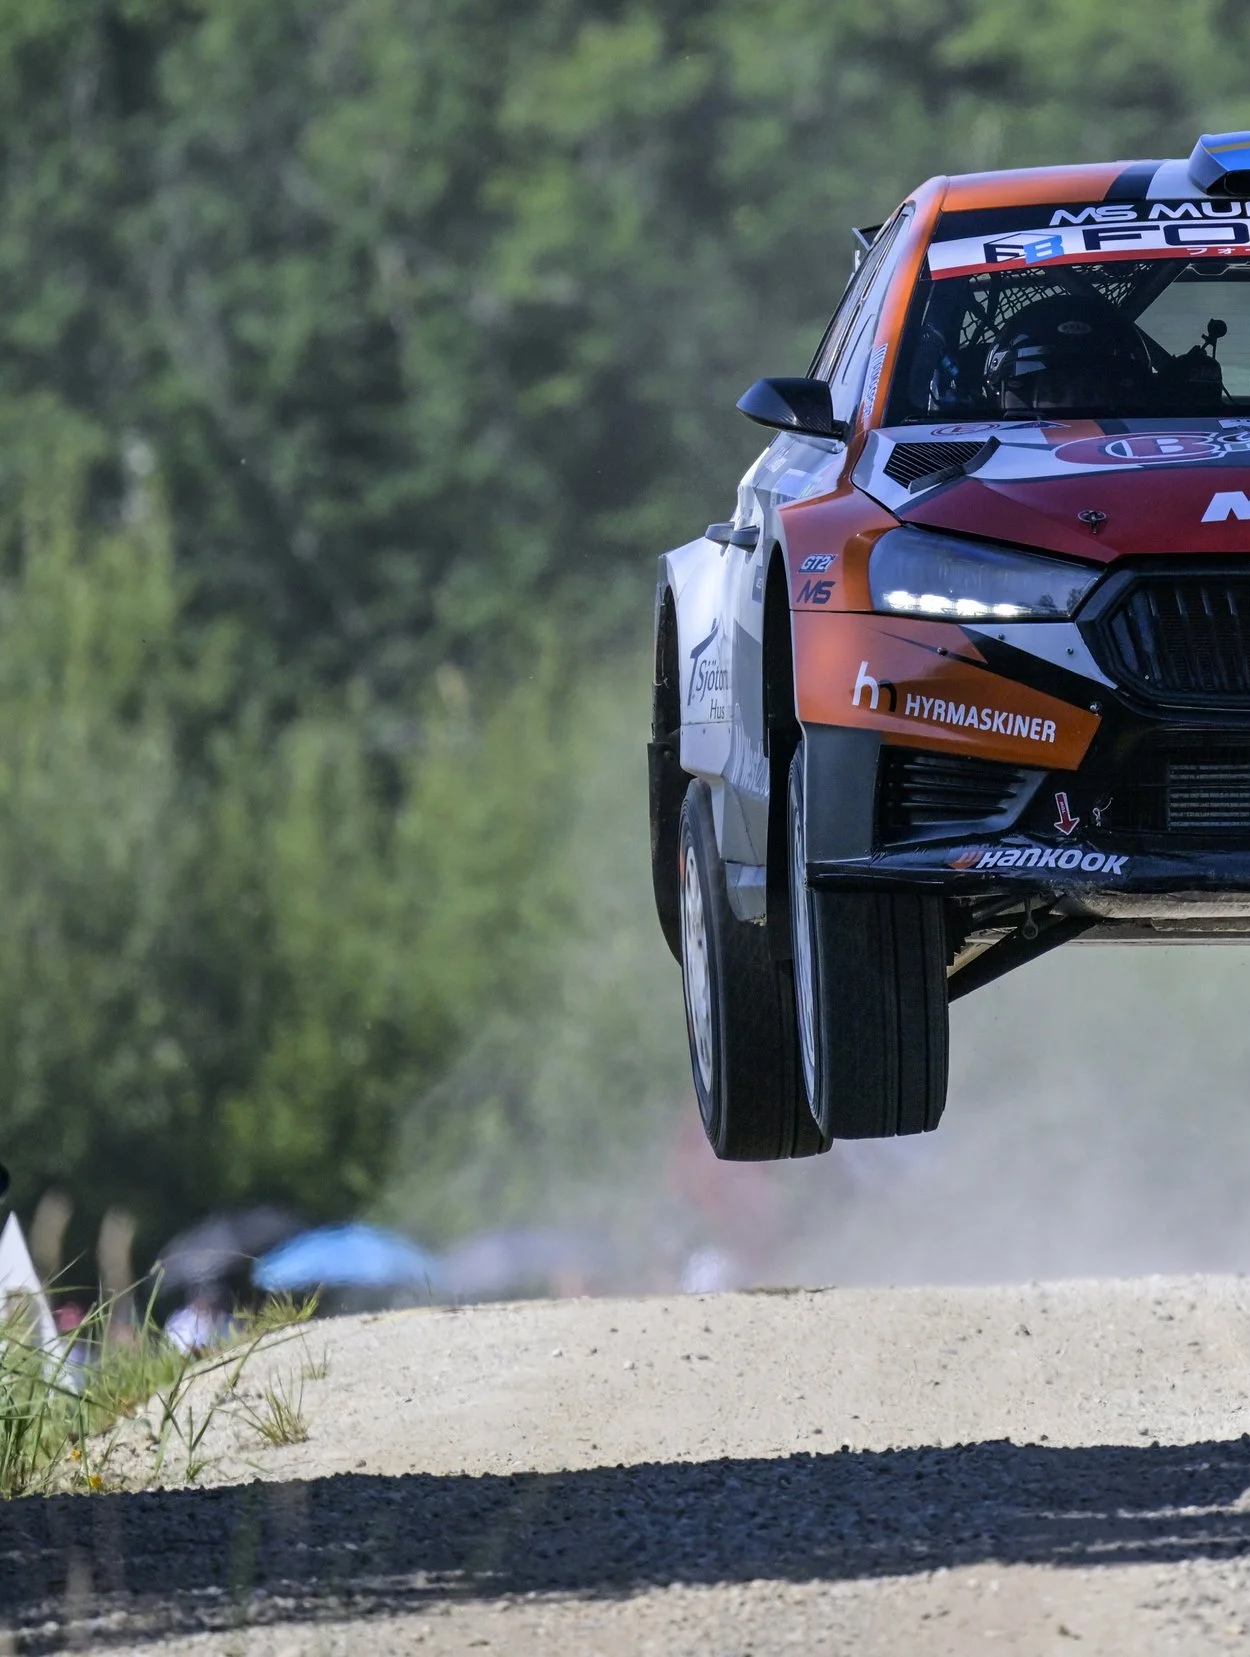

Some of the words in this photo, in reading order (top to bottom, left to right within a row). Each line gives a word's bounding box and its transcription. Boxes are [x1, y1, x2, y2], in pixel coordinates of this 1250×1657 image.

[1050, 205, 1137, 226] MS
[710, 698, 725, 720] Hus
[904, 693, 1057, 743] HYRMASKINER
